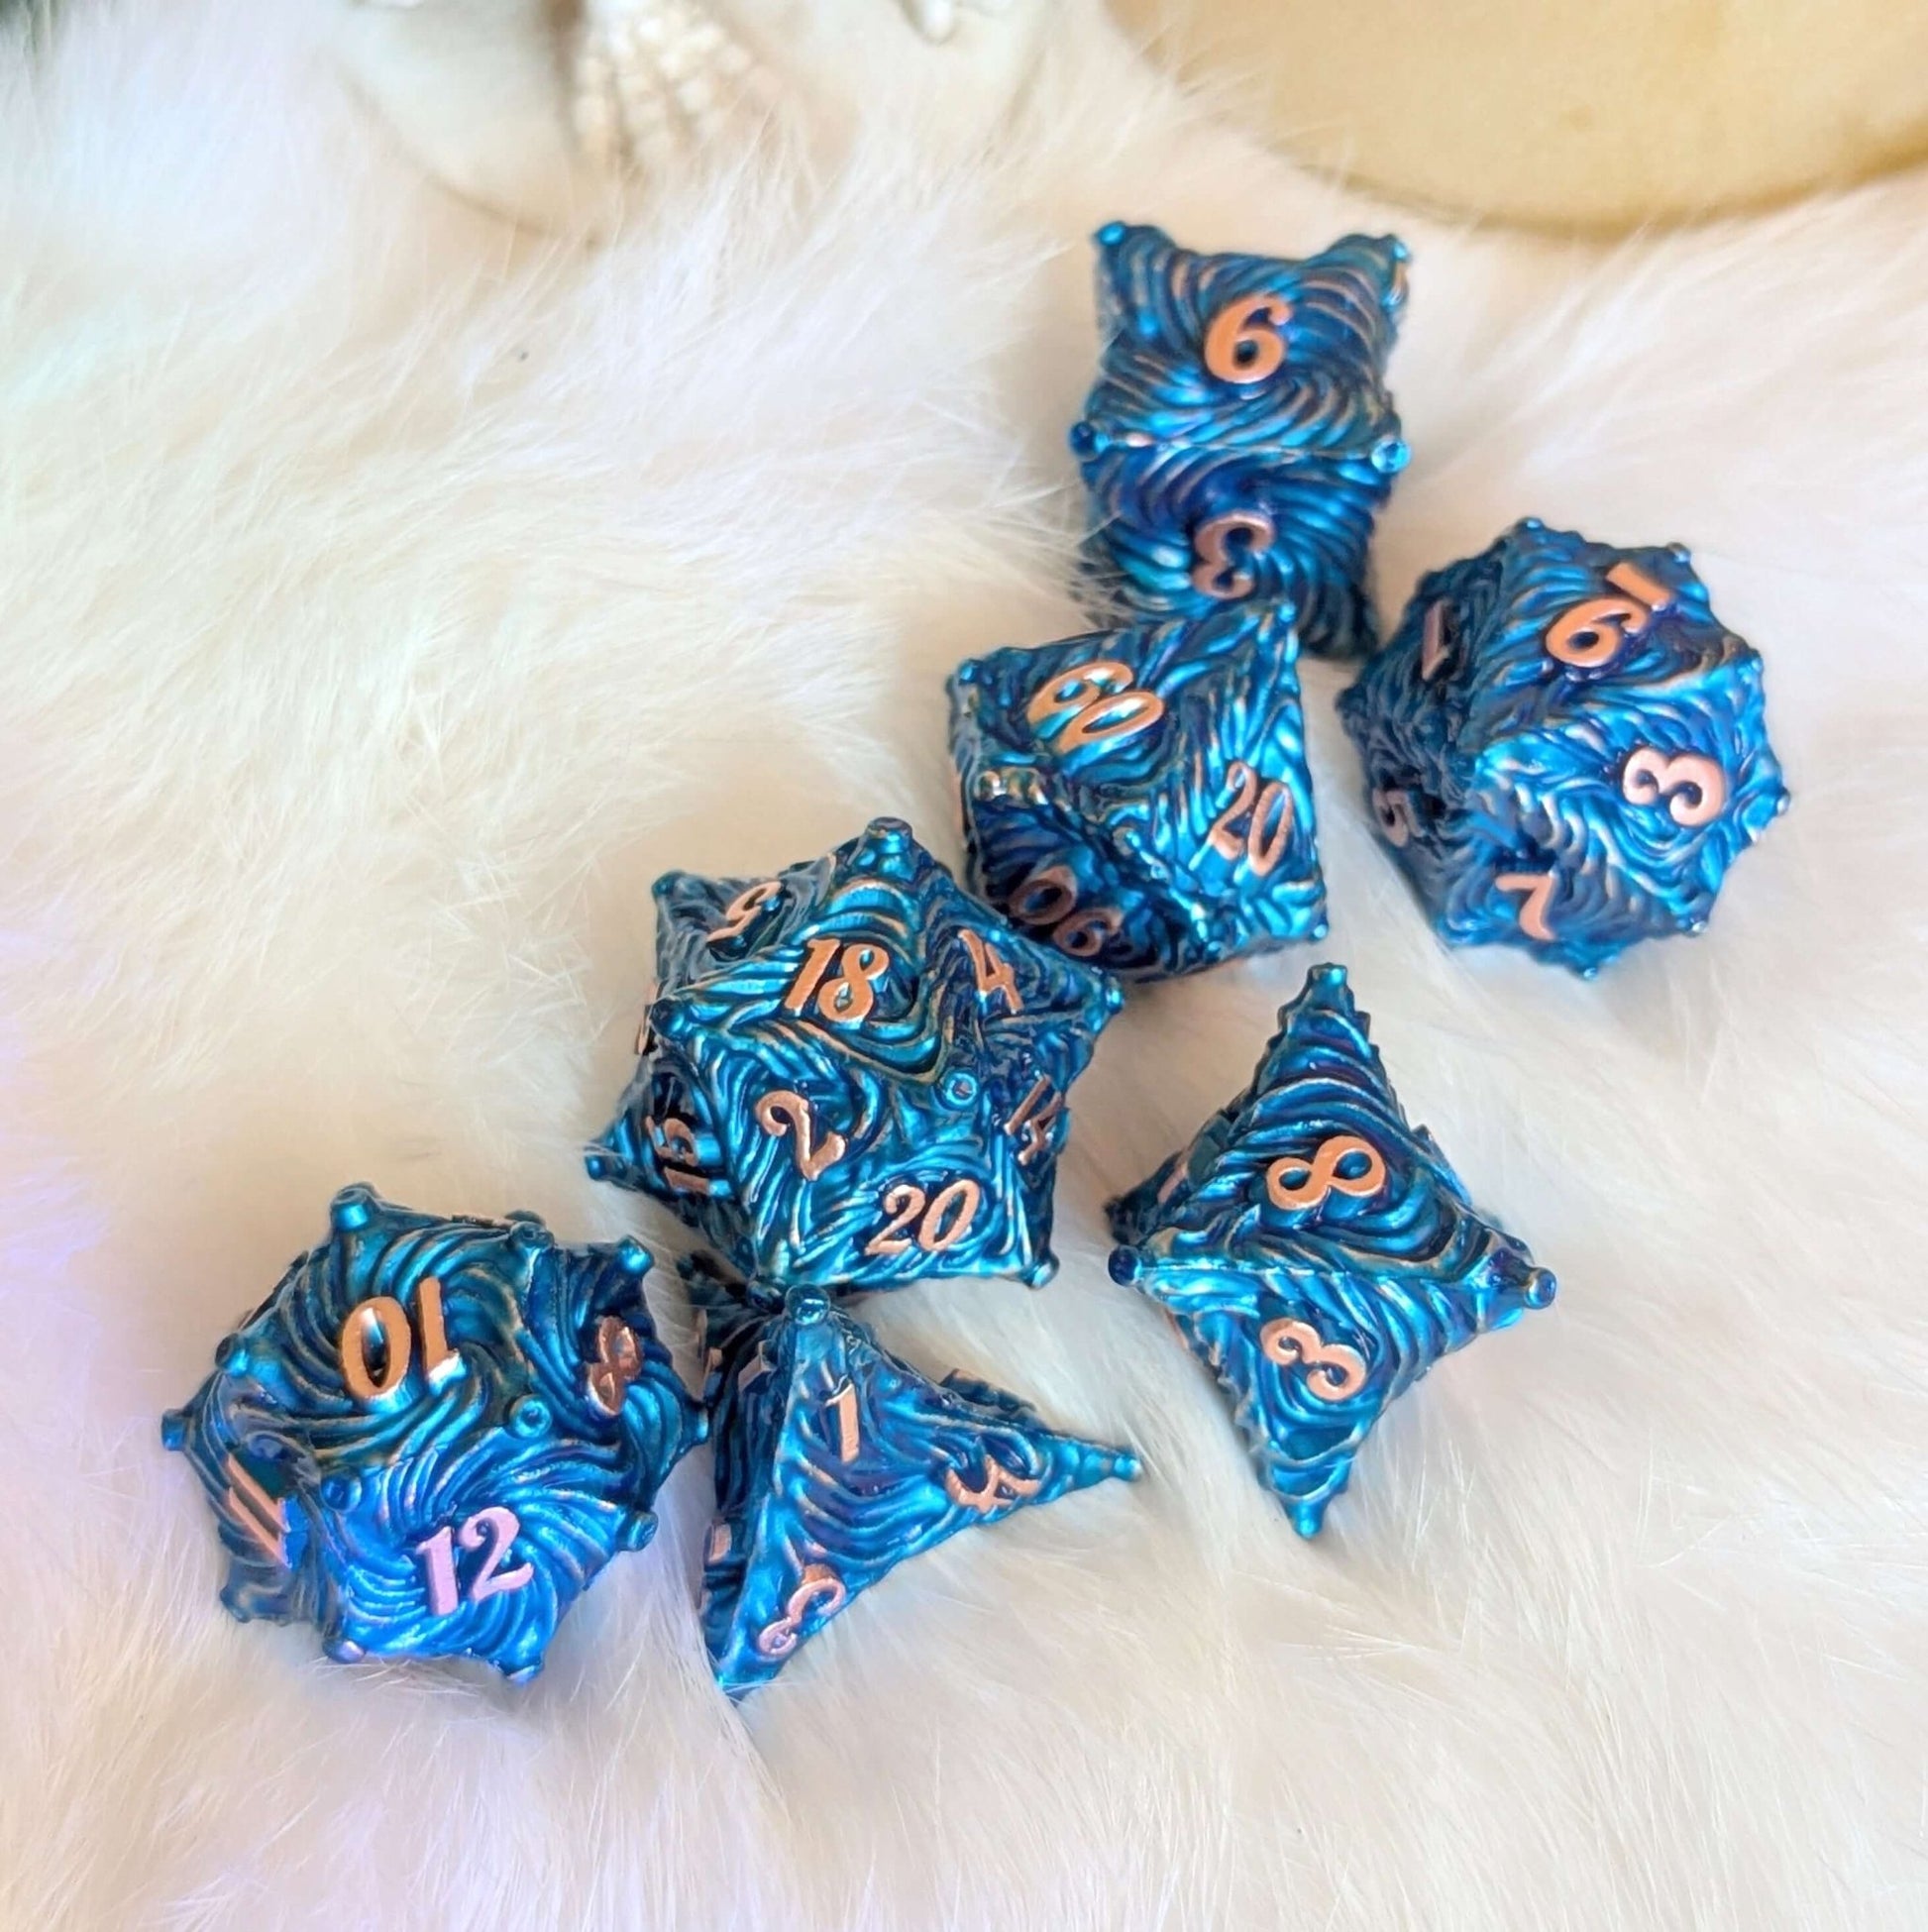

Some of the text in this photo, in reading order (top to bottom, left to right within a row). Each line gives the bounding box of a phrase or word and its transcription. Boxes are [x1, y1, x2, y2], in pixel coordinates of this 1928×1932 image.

[1204, 294, 1292, 383] 6
[1194, 509, 1276, 598] 3
[1210, 760, 1294, 877] 20
[1622, 747, 1725, 827] 3
[784, 937, 890, 1022] 18
[956, 928, 1023, 1014] 4
[755, 1089, 846, 1181] 2
[1267, 1135, 1386, 1210] 8
[864, 1178, 981, 1257] 20
[1259, 1318, 1367, 1402] 3
[824, 1381, 860, 1465] 1
[415, 1506, 535, 1617] 12
